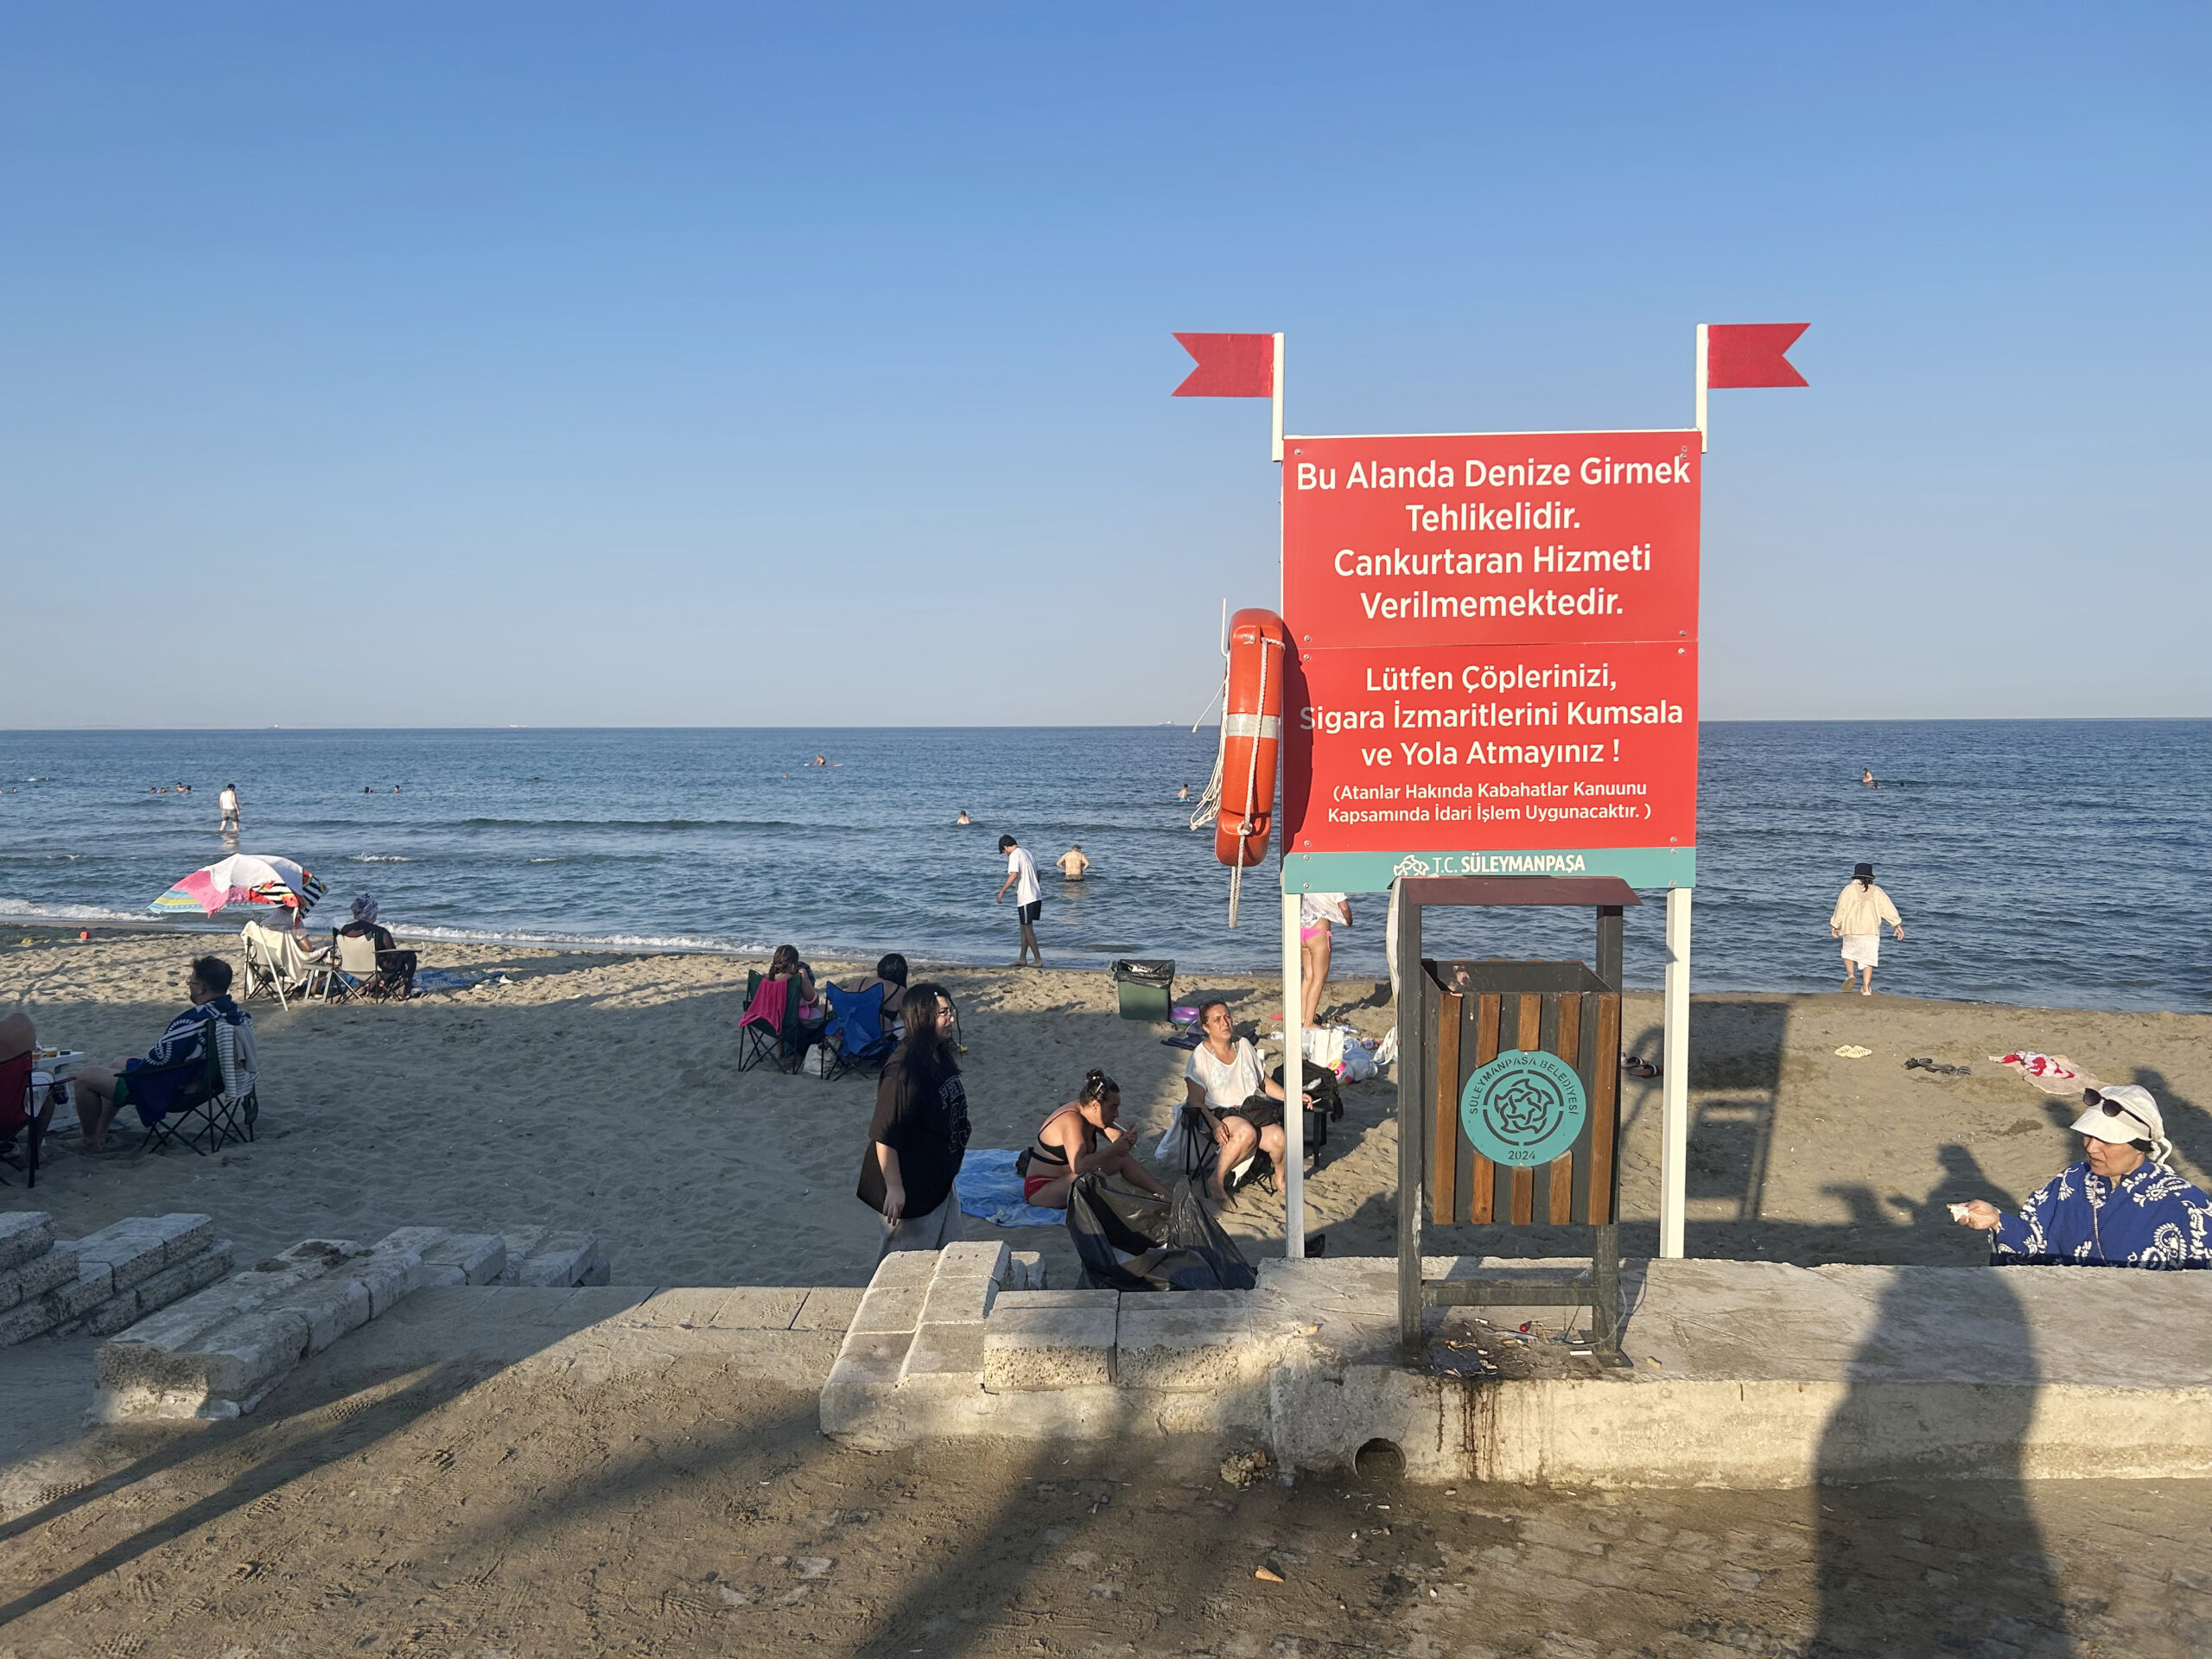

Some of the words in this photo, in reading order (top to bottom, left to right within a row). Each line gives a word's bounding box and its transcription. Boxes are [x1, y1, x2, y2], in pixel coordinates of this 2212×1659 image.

[1297, 462, 1336, 491] Bu
[1345, 459, 1454, 489] Alanda
[1465, 457, 1571, 487] Denize
[1580, 454, 1691, 485] Girmek
[1405, 500, 1580, 532] Tehlikelidir.
[1334, 547, 1522, 577] Cankurtaran
[1534, 543, 1651, 573] Hizmeti
[1360, 587, 1623, 620] Verilmemektedir.
[1366, 665, 1452, 691] Lütfen
[1462, 663, 1617, 694] Çöplerinizi,
[1300, 704, 1384, 734] Sigara
[1394, 700, 1558, 728] İzmaritlerini
[1567, 699, 1683, 725] Kumsala
[1361, 747, 1392, 766] ve
[1400, 741, 1458, 766] Yola
[1465, 741, 1605, 768] Atmayınız
[1333, 784, 1402, 803] (Atanlar
[1406, 783, 1473, 799] Hakında
[1478, 781, 1569, 798] Kabahatlar
[1573, 781, 1647, 797] Kanuunu
[1328, 806, 1430, 825] Kapsamında
[1435, 803, 1471, 821] İdari
[1477, 803, 1521, 823] İşlem
[1525, 803, 1639, 823] Uygunacaktır.
[1432, 856, 1458, 874] T.C.
[1461, 852, 1586, 874] SÜLEYMANPAŞA
[1508, 1150, 1535, 1160] 2024
